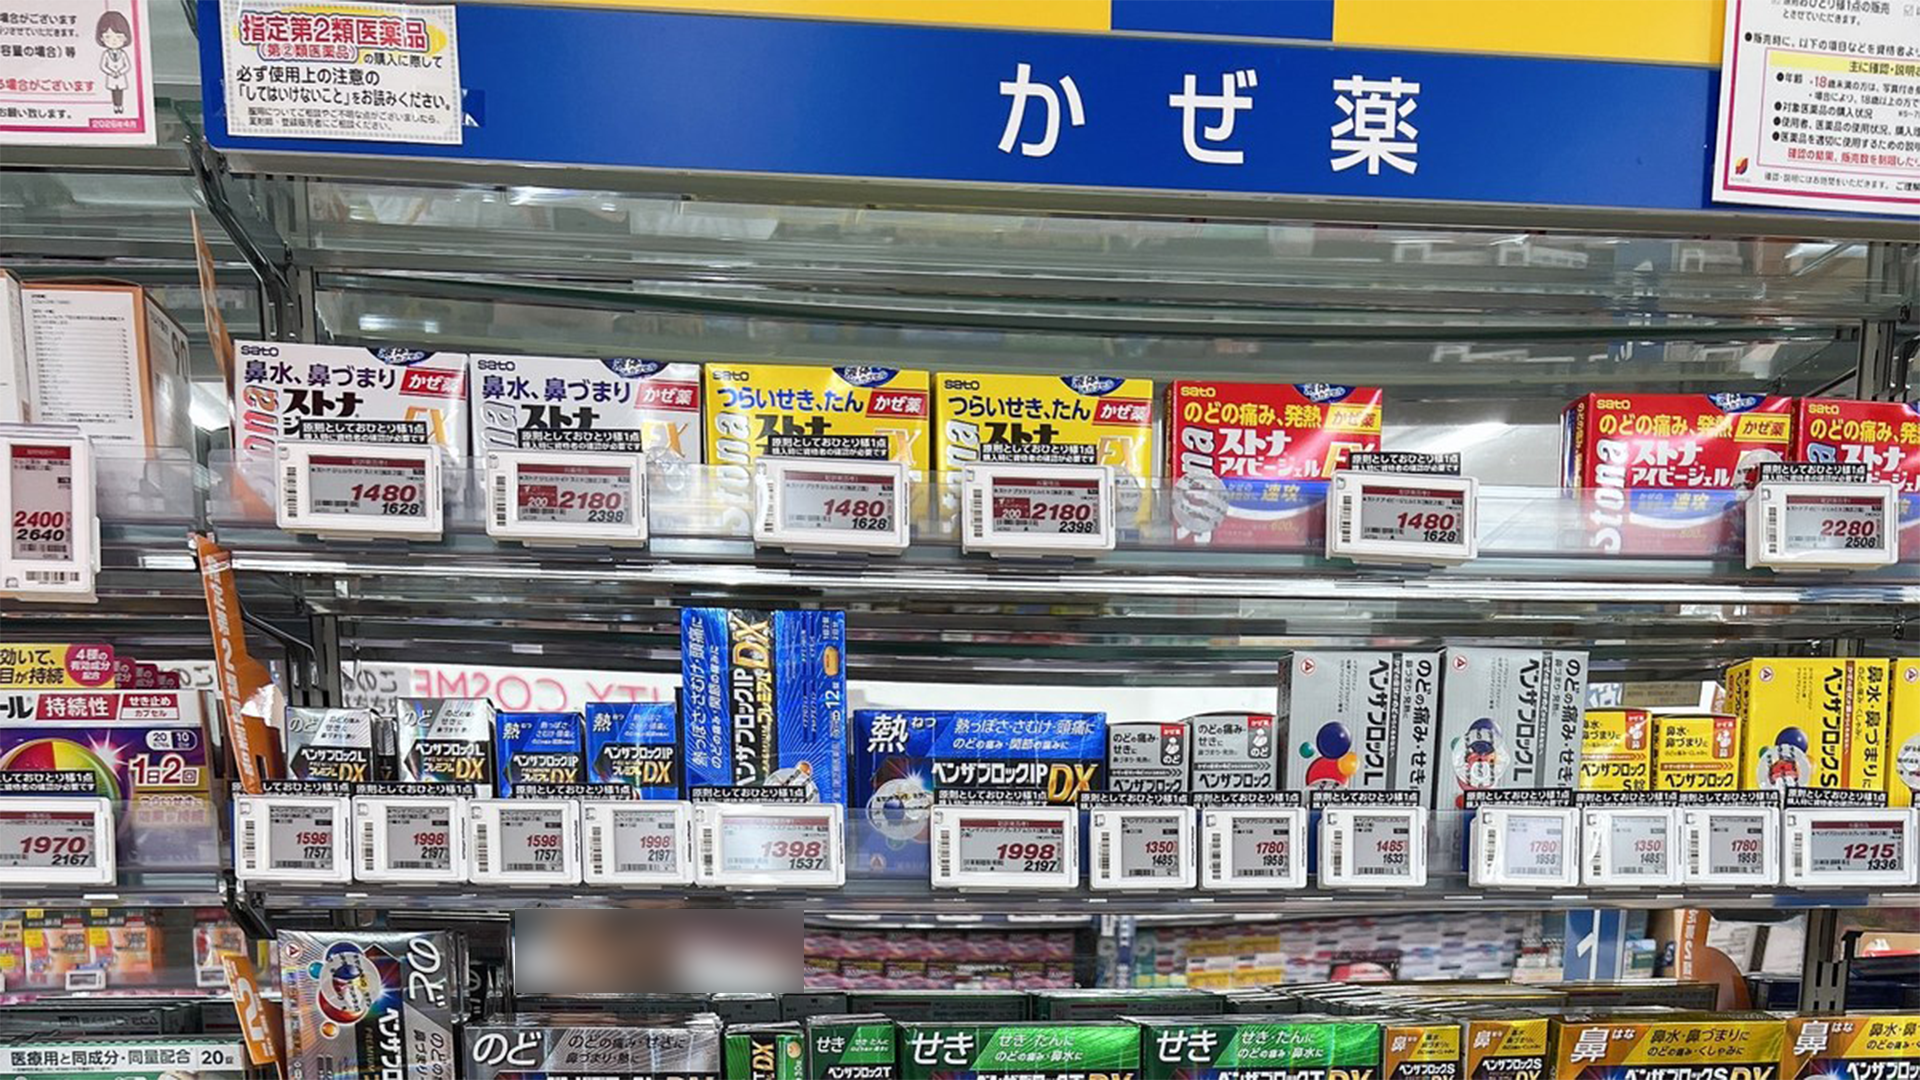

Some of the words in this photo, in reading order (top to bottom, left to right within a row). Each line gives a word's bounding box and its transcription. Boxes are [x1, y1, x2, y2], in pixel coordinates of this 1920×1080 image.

[242, 14, 427, 49] 指定第2類医薬品
[364, 53, 443, 69] の購入に際して
[236, 66, 380, 86] 必ず使用上の注意の
[998, 63, 1420, 175] かぜ薬
[477, 360, 516, 372] sato
[244, 360, 397, 389] 鼻水、鼻づまり
[408, 372, 461, 393] かぜ薬
[482, 375, 632, 404] 鼻水、鼻づまり
[1180, 387, 1216, 398] sato
[282, 388, 364, 418] ストナ
[643, 387, 694, 406] かぜ薬
[717, 387, 865, 413] つらいせき、たん
[873, 394, 923, 413] かぜ薬
[949, 396, 1091, 421] つらいせき、たん
[1596, 399, 1631, 410] sato
[1808, 404, 1840, 414] sato
[520, 404, 600, 430] ストナ
[1100, 402, 1148, 422] かぜ薬
[1183, 402, 1322, 428] のどの痛み、発熱
[1331, 410, 1377, 428] かぜ薬
[302, 422, 426, 435] 原則としておひとり様1点
[1599, 415, 1733, 438] のどの痛み、発熱
[1742, 421, 1786, 436] かぜ薬
[521, 431, 640, 443] 原則としておひとり様1点
[771, 437, 887, 449] 原則としておひとり様1点
[1217, 427, 1292, 456] ストナ
[982, 443, 1095, 455] 原則としておひとり様1点
[1630, 440, 1703, 466] ストナ
[1352, 453, 1459, 464] 原則としておひとり様1点
[1841, 444, 1906, 471] ストナ
[1218, 456, 1323, 478] アイビージェル
[1762, 464, 1866, 475] 原則としておひとり様1点
[1630, 466, 1730, 487] アイビージェル
[351, 484, 417, 502] 1480
[559, 491, 621, 510] 2180
[382, 503, 420, 515] 1628
[823, 498, 885, 517] 1480
[1002, 508, 1021, 518] 200
[1031, 502, 1091, 520] 2180
[14, 511, 64, 528] 2400
[588, 510, 624, 523] 2398
[1397, 512, 1455, 530] 1480
[851, 517, 887, 530] 1628
[1059, 521, 1093, 533] 2398
[1820, 520, 1875, 536] 2280
[16, 529, 64, 541] 2640
[1423, 530, 1457, 542] 1628
[1845, 537, 1876, 548] 2508
[732, 620, 770, 669] DX
[76, 648, 109, 660] 4種の
[45, 696, 110, 717] 持続性
[129, 696, 171, 706] せき止め
[135, 709, 167, 718] カプセル
[1513, 658, 1540, 782] ベンザブロックL
[592, 713, 612, 732] 熱
[912, 716, 937, 728] ねつ
[1364, 659, 1390, 786] ベンザブロックL
[1820, 667, 1846, 788] ベンザブロックS
[1861, 665, 1883, 788] 鼻水・鼻づまりに
[502, 721, 521, 739] 熱
[866, 713, 909, 753] 熱
[153, 733, 167, 741] 20
[176, 733, 189, 741] 10
[604, 747, 673, 760] ベンザブロックIP
[1251, 748, 1269, 757] のど
[1162, 755, 1181, 765] のど
[131, 753, 198, 785] 1日2回
[455, 757, 485, 779] DX
[642, 761, 673, 783] DX
[932, 763, 1048, 785] ベンザブロックIP
[1582, 763, 1646, 777] ベンザブロック
[1047, 764, 1097, 806] DX
[1113, 779, 1183, 792] ベンザブロック
[1199, 773, 1273, 788] ベンザブロック
[1665, 773, 1734, 788] ベンザブロック
[356, 783, 474, 795] 原則としておひとり様1点
[515, 785, 631, 796] 原則としておひとり様1点
[692, 787, 805, 798] 原則としておひとり様1点
[939, 790, 1048, 800] 原則としておひとり様1点
[1787, 789, 1886, 802] 原則としておひとり様1点
[1081, 793, 1188, 803] 原則としておひとり様1点
[1194, 793, 1300, 803] 原則としておひとり様1点
[1312, 791, 1418, 802] 原則としておひとり様1点
[1466, 790, 1571, 802] 原則としておひとり様1点
[1576, 793, 1677, 803] 原則としておひとり様1点
[1679, 792, 1778, 802] 原則としておひとり様1点
[296, 832, 327, 844] 1598
[413, 833, 444, 845] 1998
[526, 835, 557, 847] 1598
[640, 836, 670, 848] 1998
[20, 836, 86, 854] 1970
[761, 840, 822, 859] 1398
[996, 843, 1055, 860] 1998
[1145, 841, 1174, 853] 1350
[1256, 842, 1284, 854] 1780
[1376, 840, 1403, 852] 1485
[1530, 840, 1557, 853] 1780
[1634, 840, 1661, 852] 1350
[1731, 840, 1758, 851] 1780
[1843, 843, 1895, 859] 1215
[52, 854, 88, 865] 2167
[303, 847, 327, 859] 1757
[420, 848, 444, 859] 2197
[533, 849, 557, 861] 1757
[648, 849, 670, 861] 2197
[1382, 854, 1403, 864] 1633
[1640, 853, 1661, 864] 1485
[1737, 853, 1758, 863] 1958
[788, 859, 824, 869] 1537
[1023, 860, 1057, 872] 2197
[1152, 855, 1174, 865] 1485
[1263, 855, 1284, 866] 1958
[1867, 859, 1897, 870] 1336
[406, 938, 448, 1008] のど
[1612, 1027, 1635, 1040] はな
[1831, 1022, 1854, 1033] はな
[1473, 1030, 1492, 1049] 鼻
[1650, 1027, 1750, 1043] 鼻水・鼻づまりに
[1793, 1020, 1830, 1056] 鼻
[472, 1031, 543, 1066] のど
[816, 1036, 846, 1053] せき
[911, 1031, 974, 1065] せき
[1156, 1030, 1218, 1063] せき
[1391, 1035, 1407, 1052] 鼻
[1571, 1027, 1609, 1063] 鼻
[11, 1049, 191, 1066] 医療用と同成分・同量配合
[1482, 1058, 1543, 1071] ベンザブロックS
